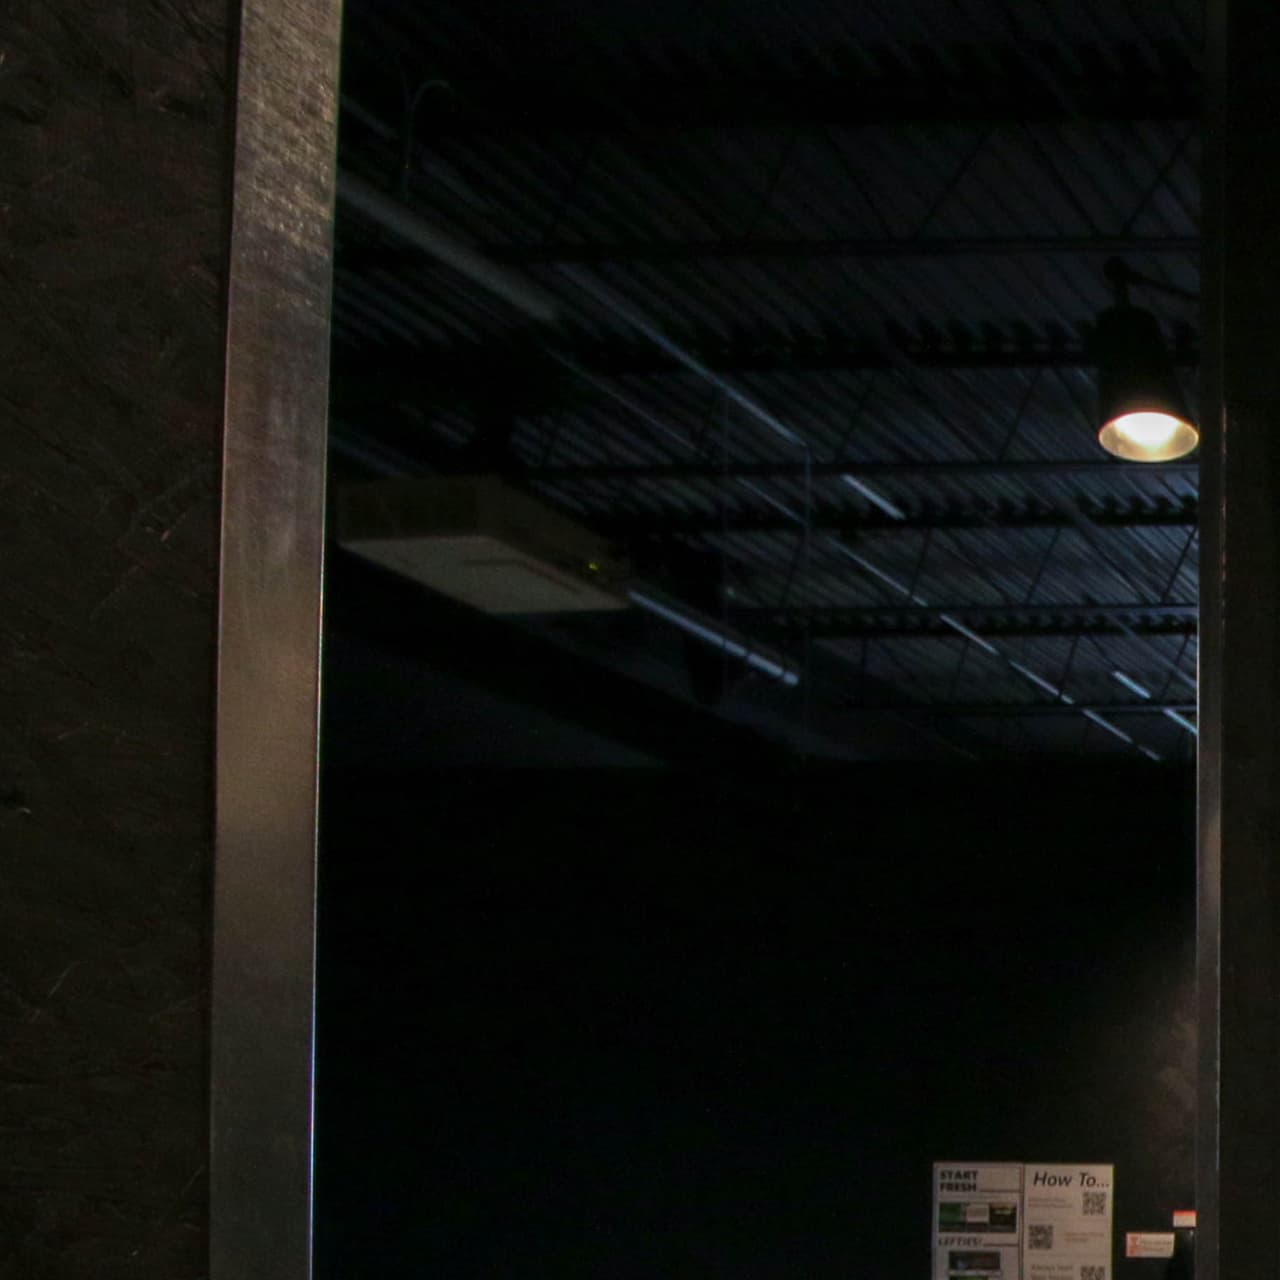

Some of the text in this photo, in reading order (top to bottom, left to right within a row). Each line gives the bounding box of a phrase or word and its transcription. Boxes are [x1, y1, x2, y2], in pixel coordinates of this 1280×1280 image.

[939, 1170, 978, 1181] START
[1033, 1171, 1072, 1187] How
[939, 1182, 977, 1192] FRESH
